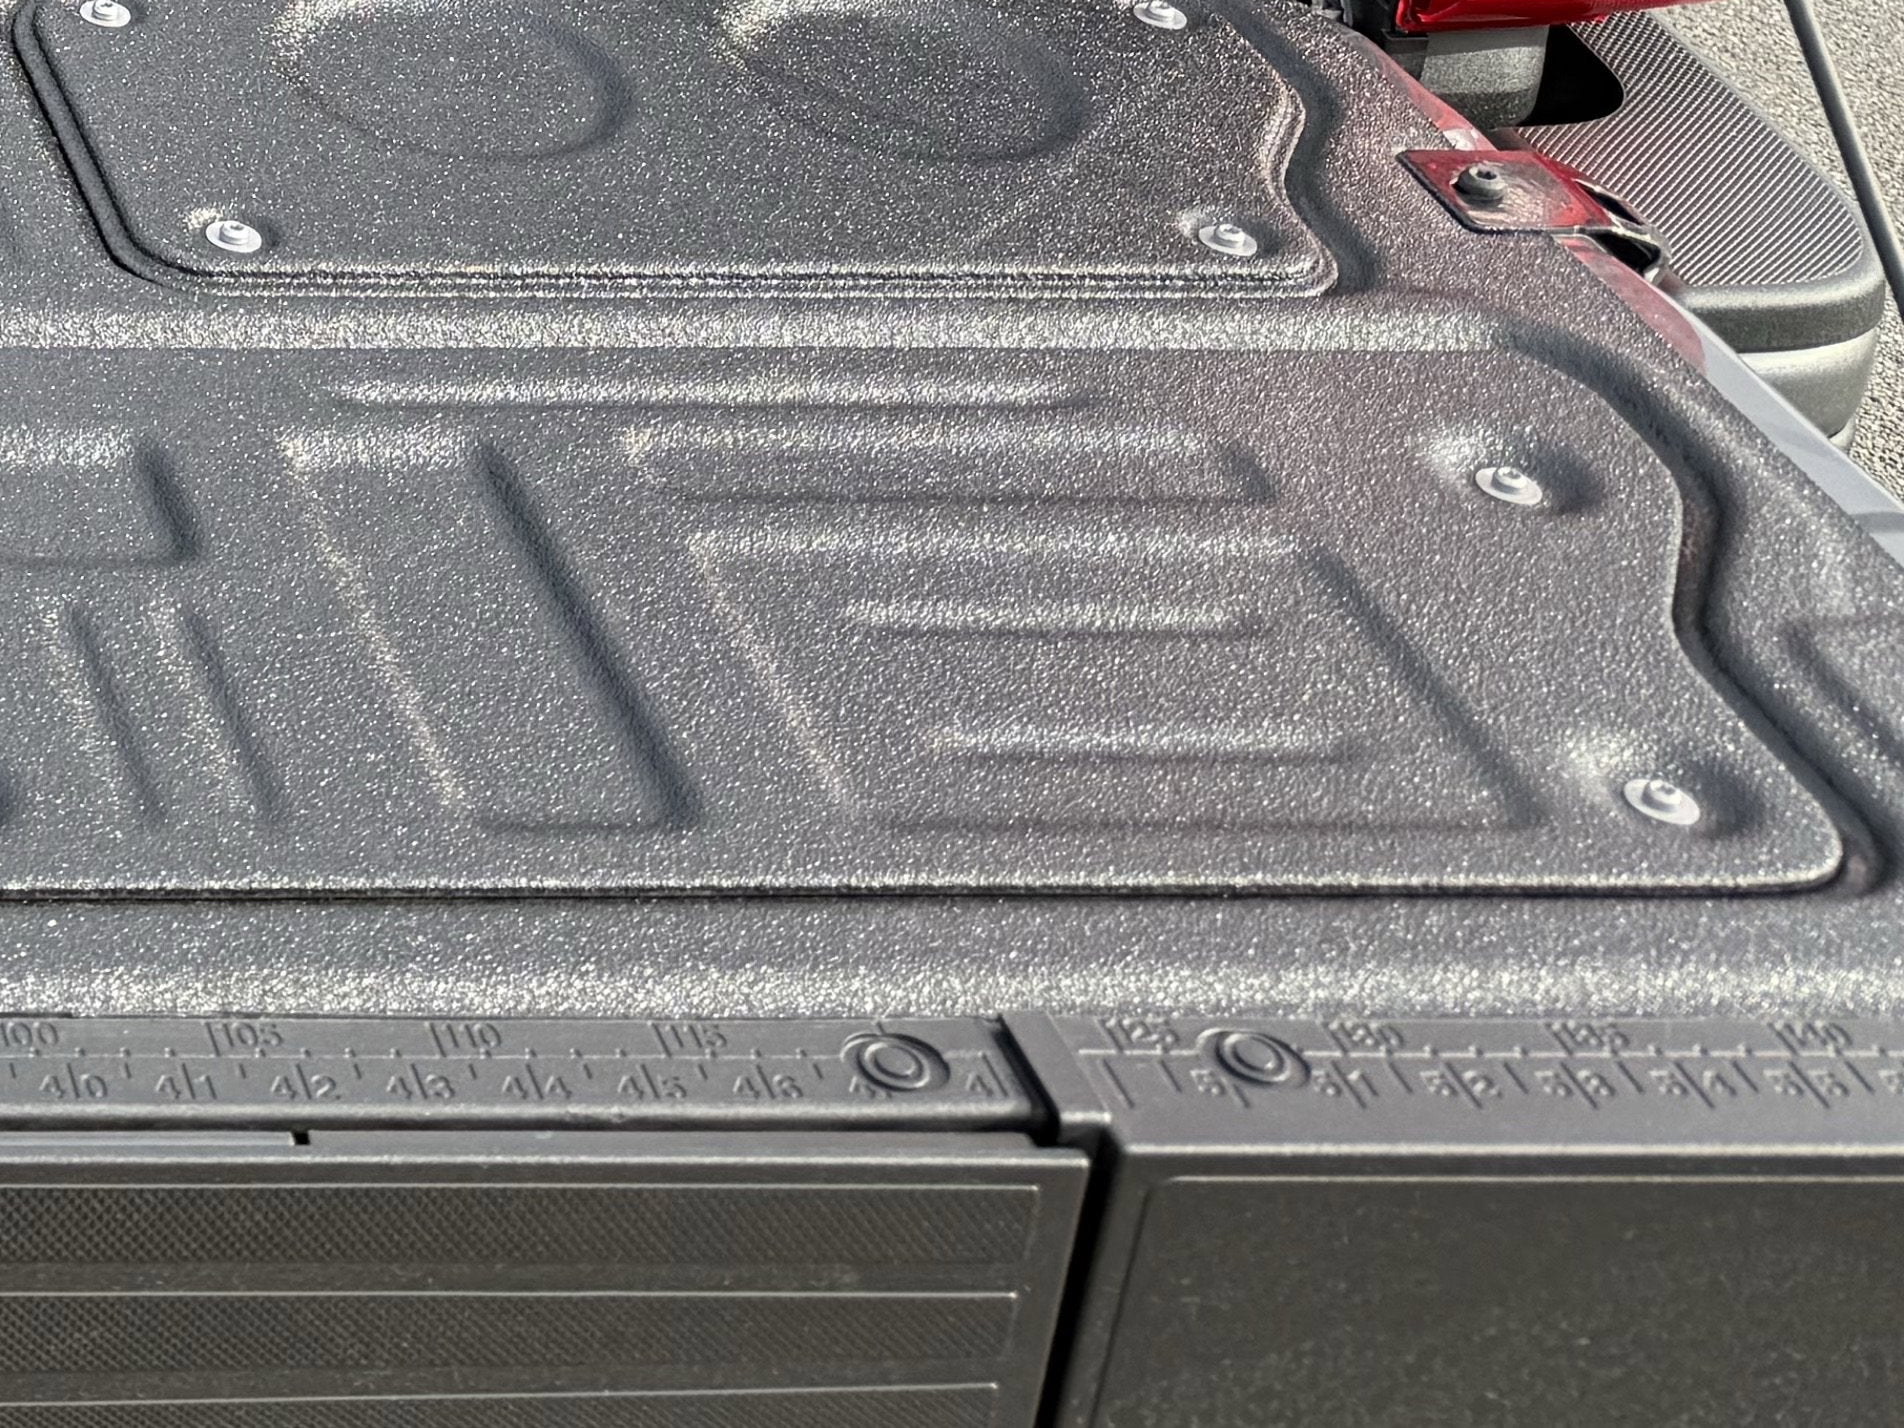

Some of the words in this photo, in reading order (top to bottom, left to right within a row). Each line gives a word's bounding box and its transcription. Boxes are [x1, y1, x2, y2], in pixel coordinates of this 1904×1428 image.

[218, 1022, 285, 1047] 105
[441, 1022, 502, 1048] 110
[666, 1023, 728, 1048] 115
[38, 1074, 109, 1100] 40
[155, 1074, 219, 1100] 41
[269, 1074, 342, 1100] 42
[385, 1074, 457, 1101] 43
[501, 1074, 573, 1101] 44
[616, 1074, 688, 1101] 45
[732, 1074, 805, 1101] 46
